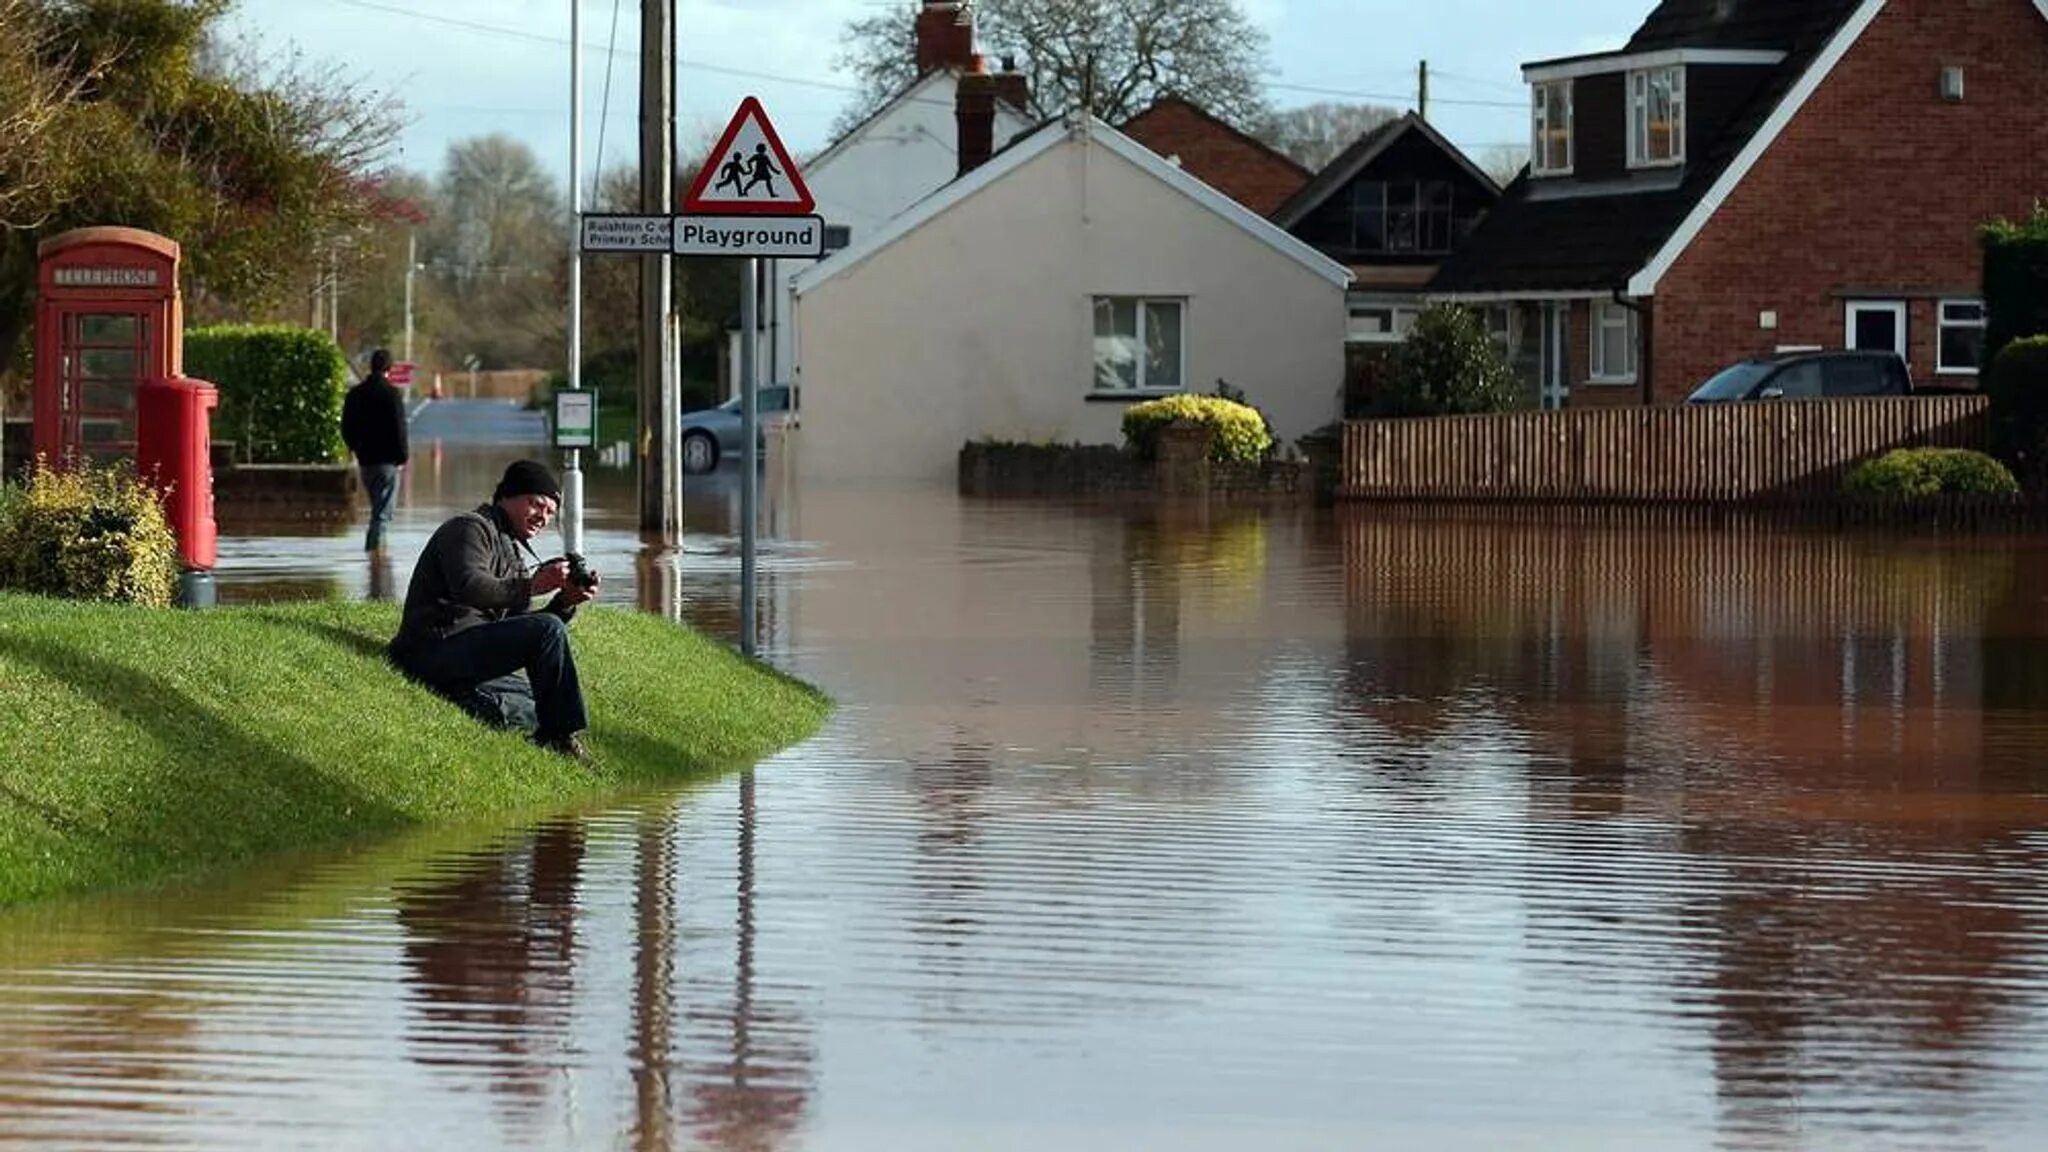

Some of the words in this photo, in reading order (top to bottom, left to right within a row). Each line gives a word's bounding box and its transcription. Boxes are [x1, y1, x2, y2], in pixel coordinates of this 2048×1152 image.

[645, 221, 656, 233] C
[590, 233, 635, 246] Primary
[683, 224, 813, 248] Playground
[56, 268, 154, 285] TELEPHONE
